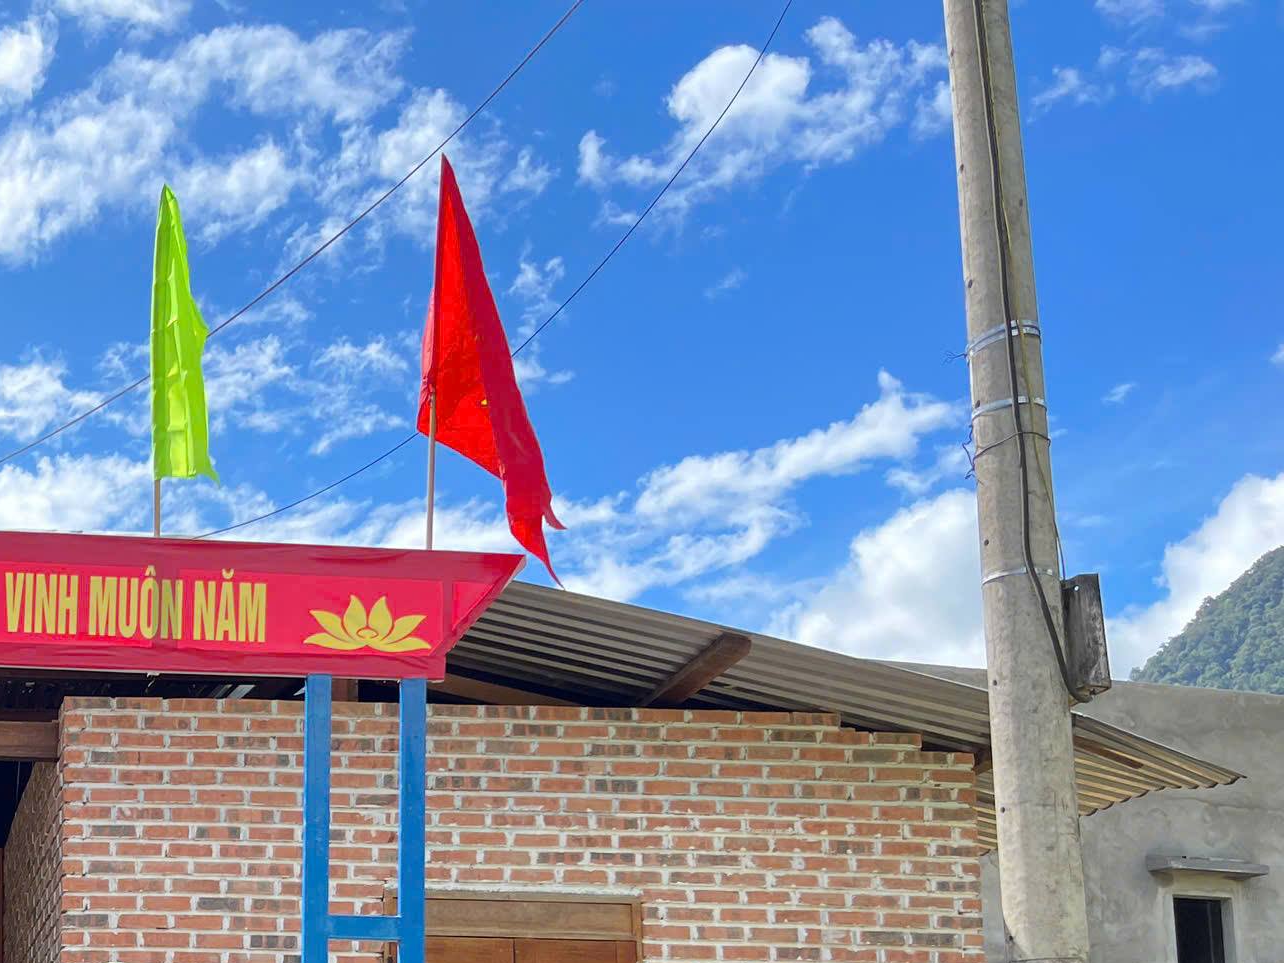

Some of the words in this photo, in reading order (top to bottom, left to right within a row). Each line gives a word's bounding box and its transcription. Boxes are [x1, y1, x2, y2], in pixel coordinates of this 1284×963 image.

[5, 572, 79, 635] VINH
[88, 565, 184, 640] MUÔN
[193, 568, 267, 643] NĂM
